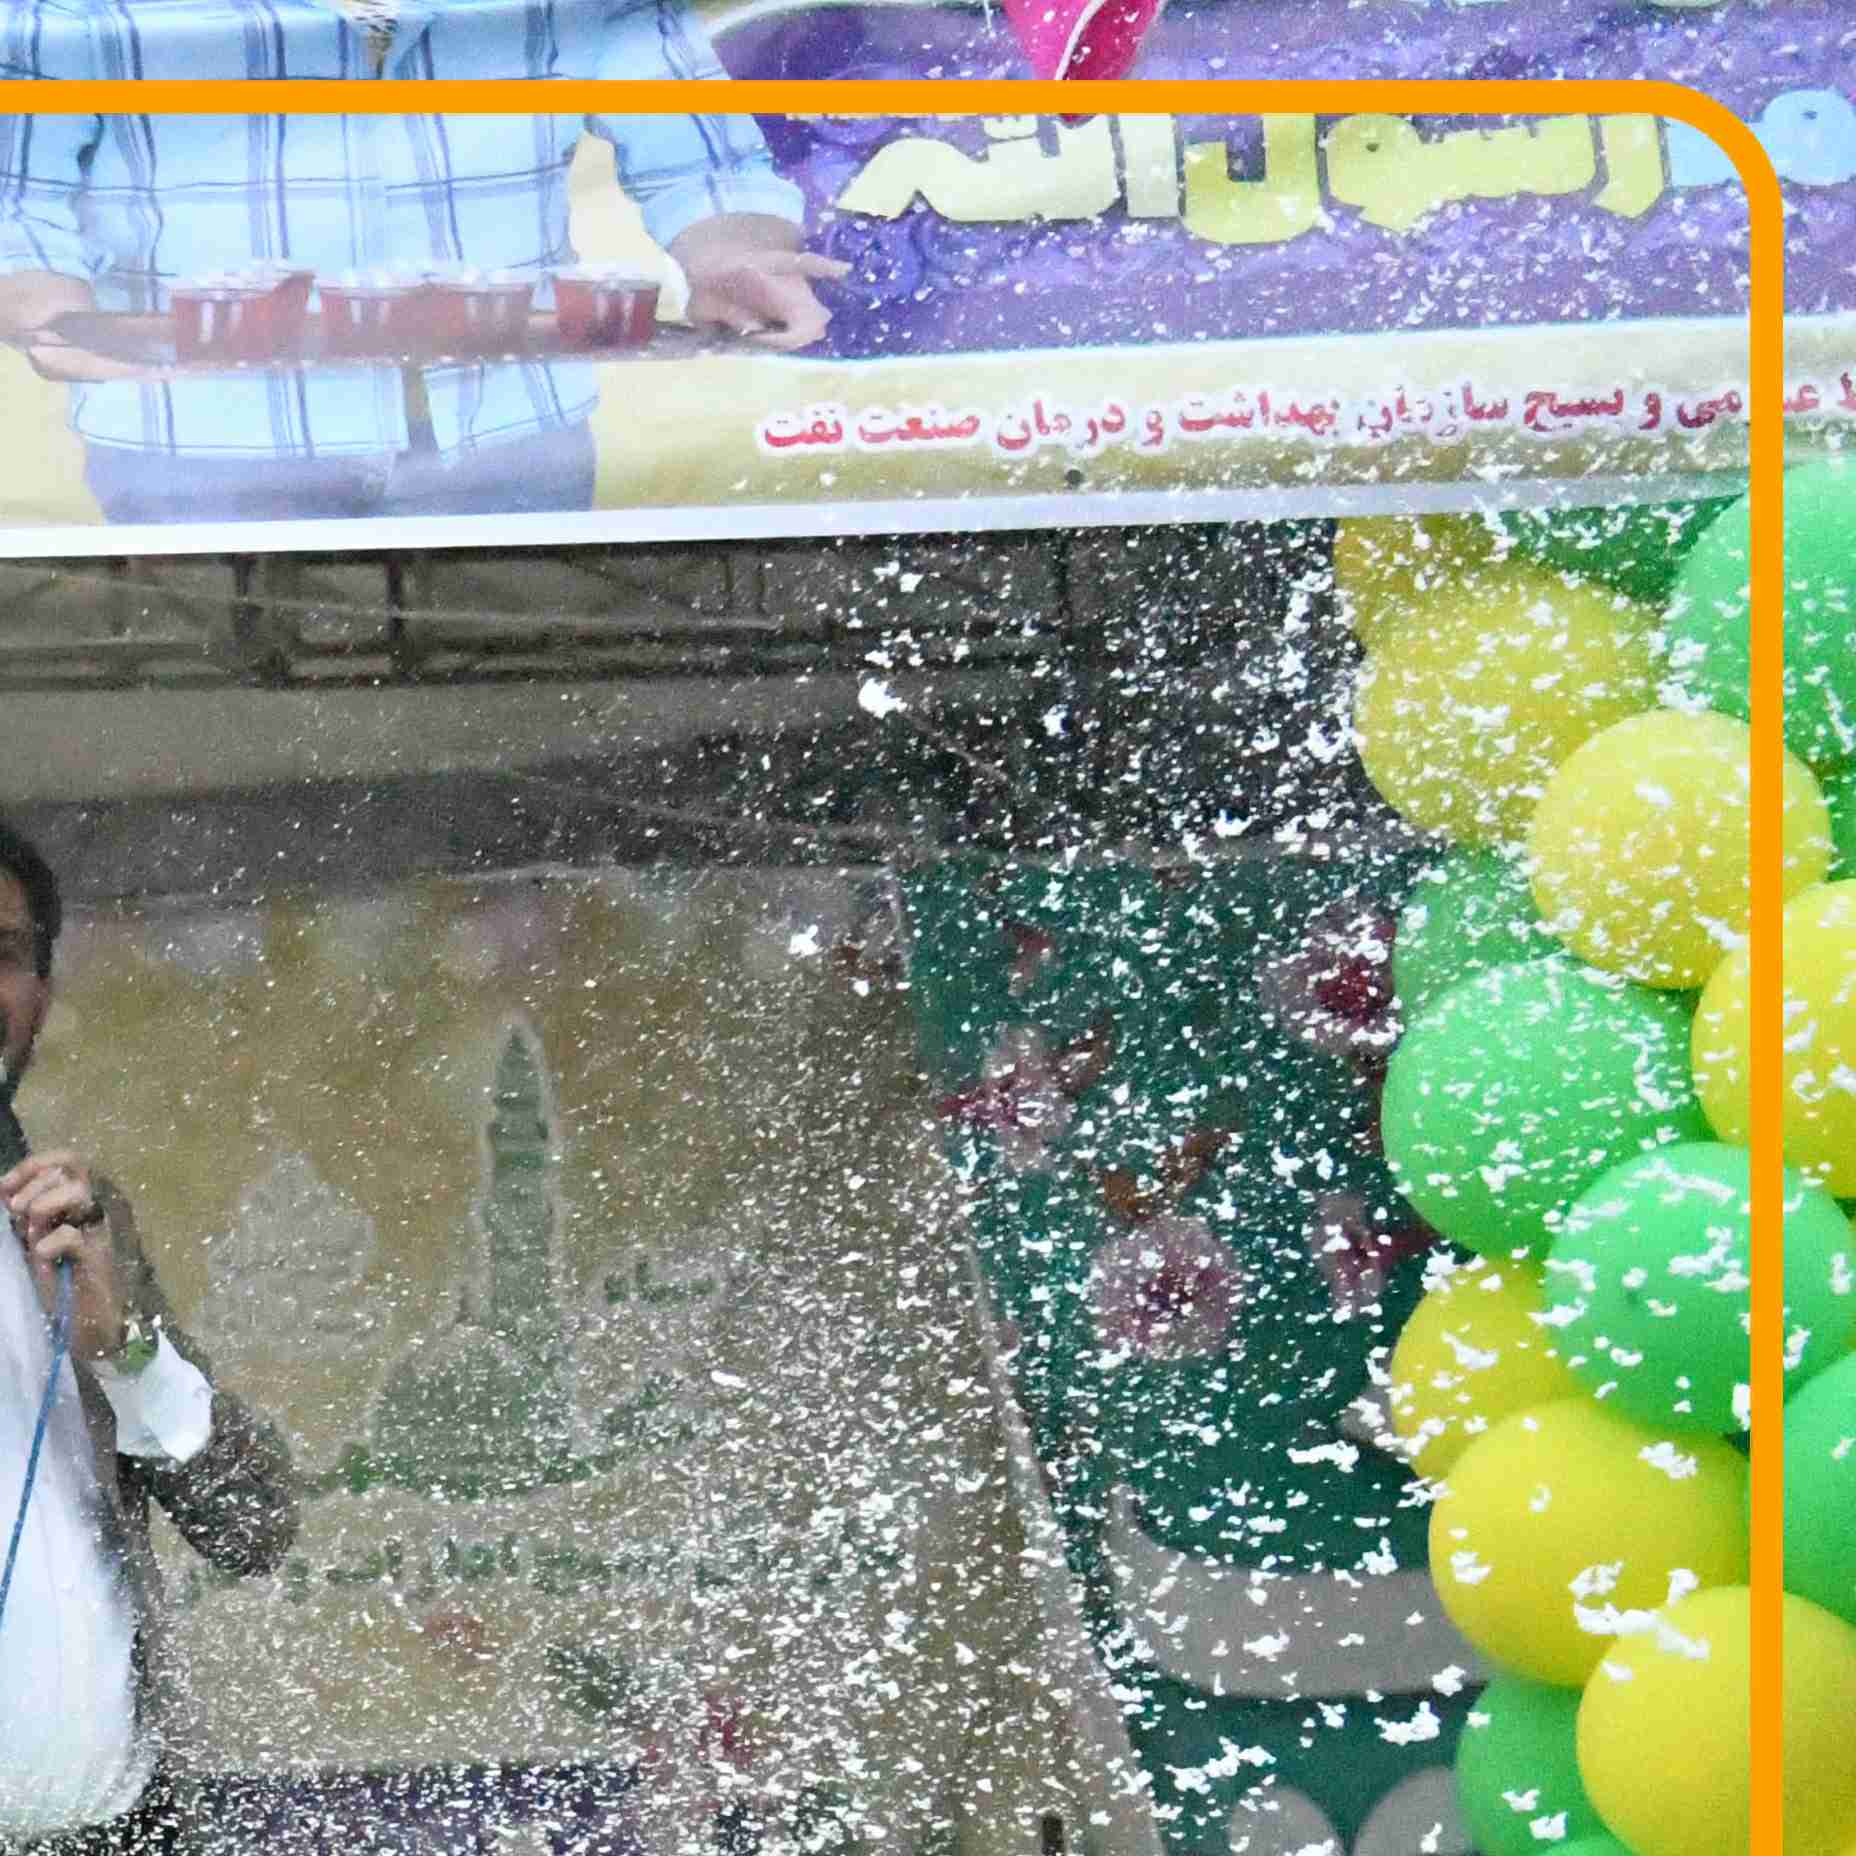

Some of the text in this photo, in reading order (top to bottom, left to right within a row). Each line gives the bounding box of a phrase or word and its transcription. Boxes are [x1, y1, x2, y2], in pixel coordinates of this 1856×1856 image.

[763, 407, 843, 449] نفت
[858, 407, 980, 443] صنعت
[995, 399, 1127, 451] درمان
[1140, 410, 1165, 449] و
[1180, 390, 1340, 437] بهداشت
[1638, 392, 1661, 431] و
